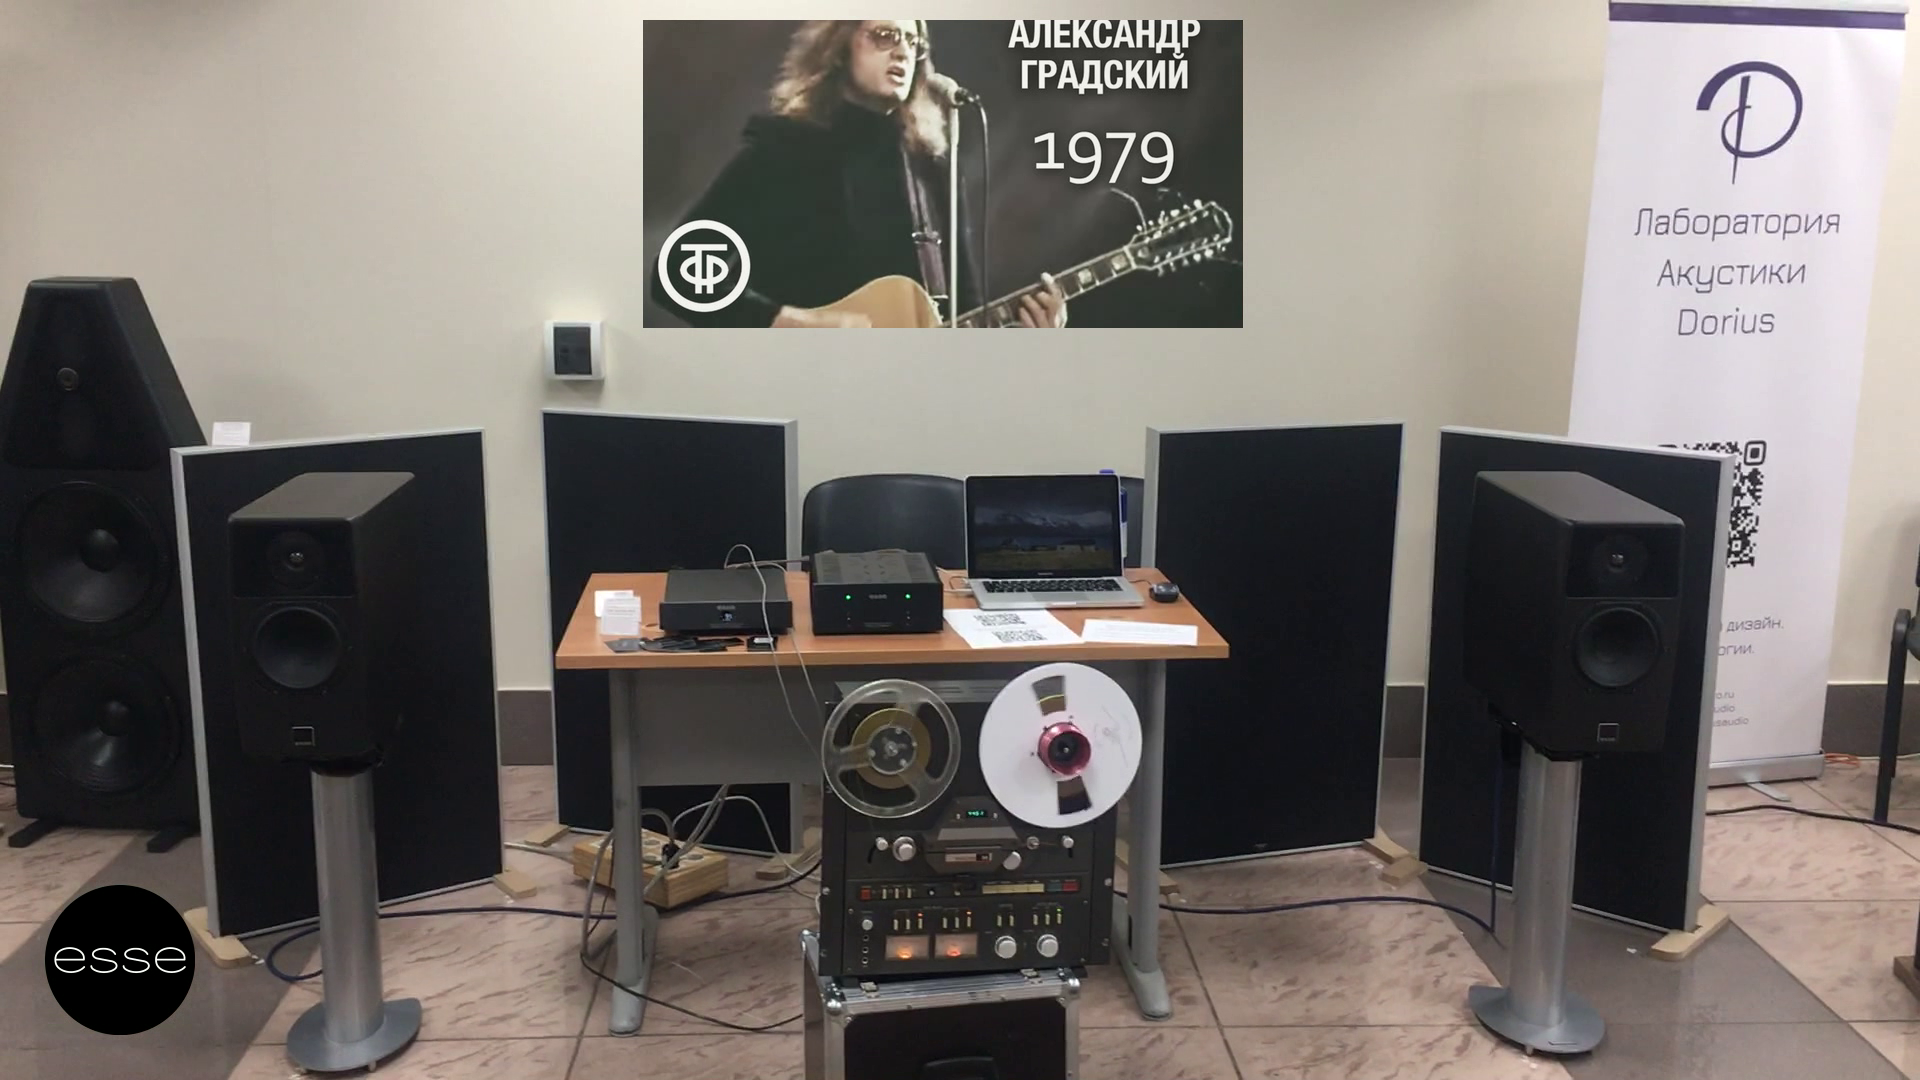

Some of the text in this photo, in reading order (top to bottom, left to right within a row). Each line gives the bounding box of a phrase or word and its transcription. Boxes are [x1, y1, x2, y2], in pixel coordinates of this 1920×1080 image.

[1633, 207, 1841, 242] Лаборатория
[1656, 258, 1807, 294] Акустики
[1677, 306, 1776, 336] Dorius
[1726, 616, 1785, 632] дизайн.
[1717, 644, 1755, 656] огии.
